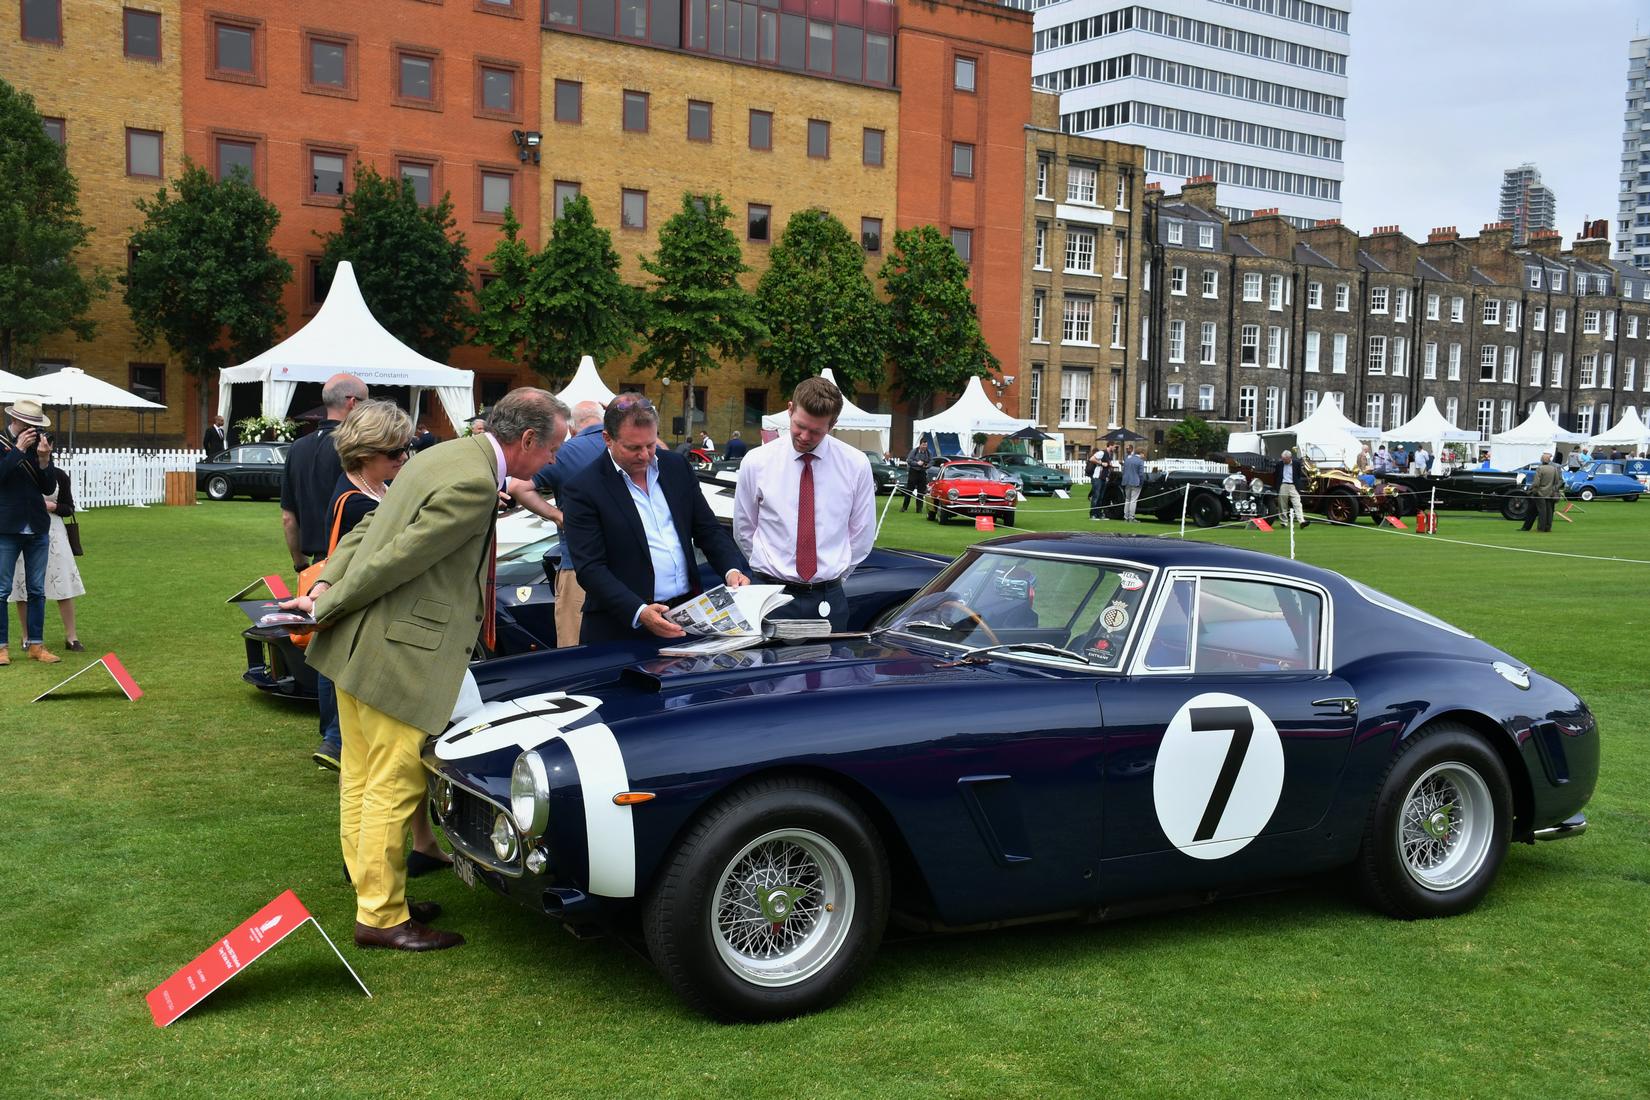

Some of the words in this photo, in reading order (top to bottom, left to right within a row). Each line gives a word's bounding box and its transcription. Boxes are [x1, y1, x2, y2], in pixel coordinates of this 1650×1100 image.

[374, 371, 409, 379] Constantin
[445, 698, 588, 744] 7
[1189, 706, 1254, 842] 7
